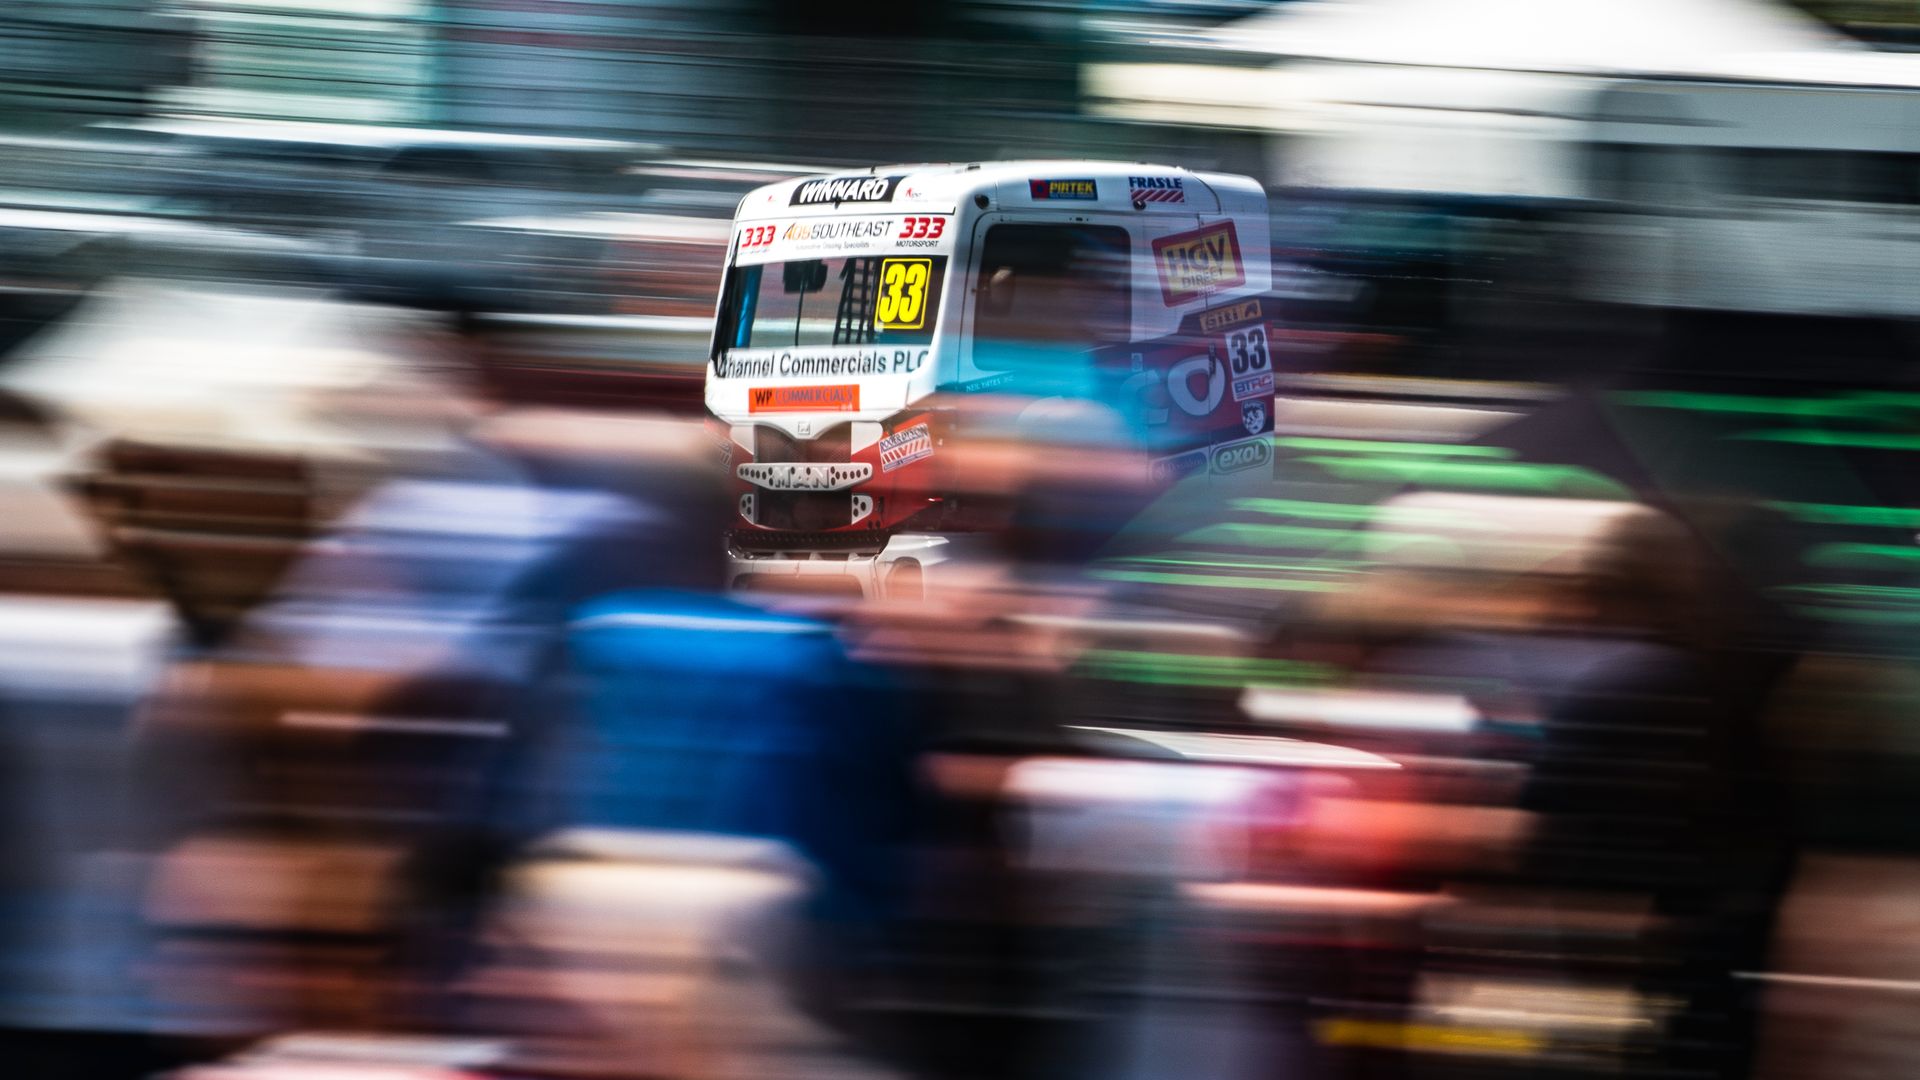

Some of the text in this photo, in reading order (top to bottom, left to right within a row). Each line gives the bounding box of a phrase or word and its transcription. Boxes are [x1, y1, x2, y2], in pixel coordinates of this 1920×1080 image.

[799, 179, 889, 204] WINNARD
[1050, 181, 1094, 193] PIRTEK
[742, 225, 776, 248] 333
[899, 217, 946, 239] 333
[895, 240, 939, 248] MOTORSPORT
[1166, 235, 1225, 277] HGV
[1182, 266, 1223, 288] DIRECT
[878, 263, 927, 323] 33
[1231, 328, 1267, 374] 33
[780, 350, 886, 376] Commercials
[1234, 374, 1273, 393] BTRC
[755, 385, 853, 406] WP COMMERCIALS
[774, 466, 830, 489] MAN
